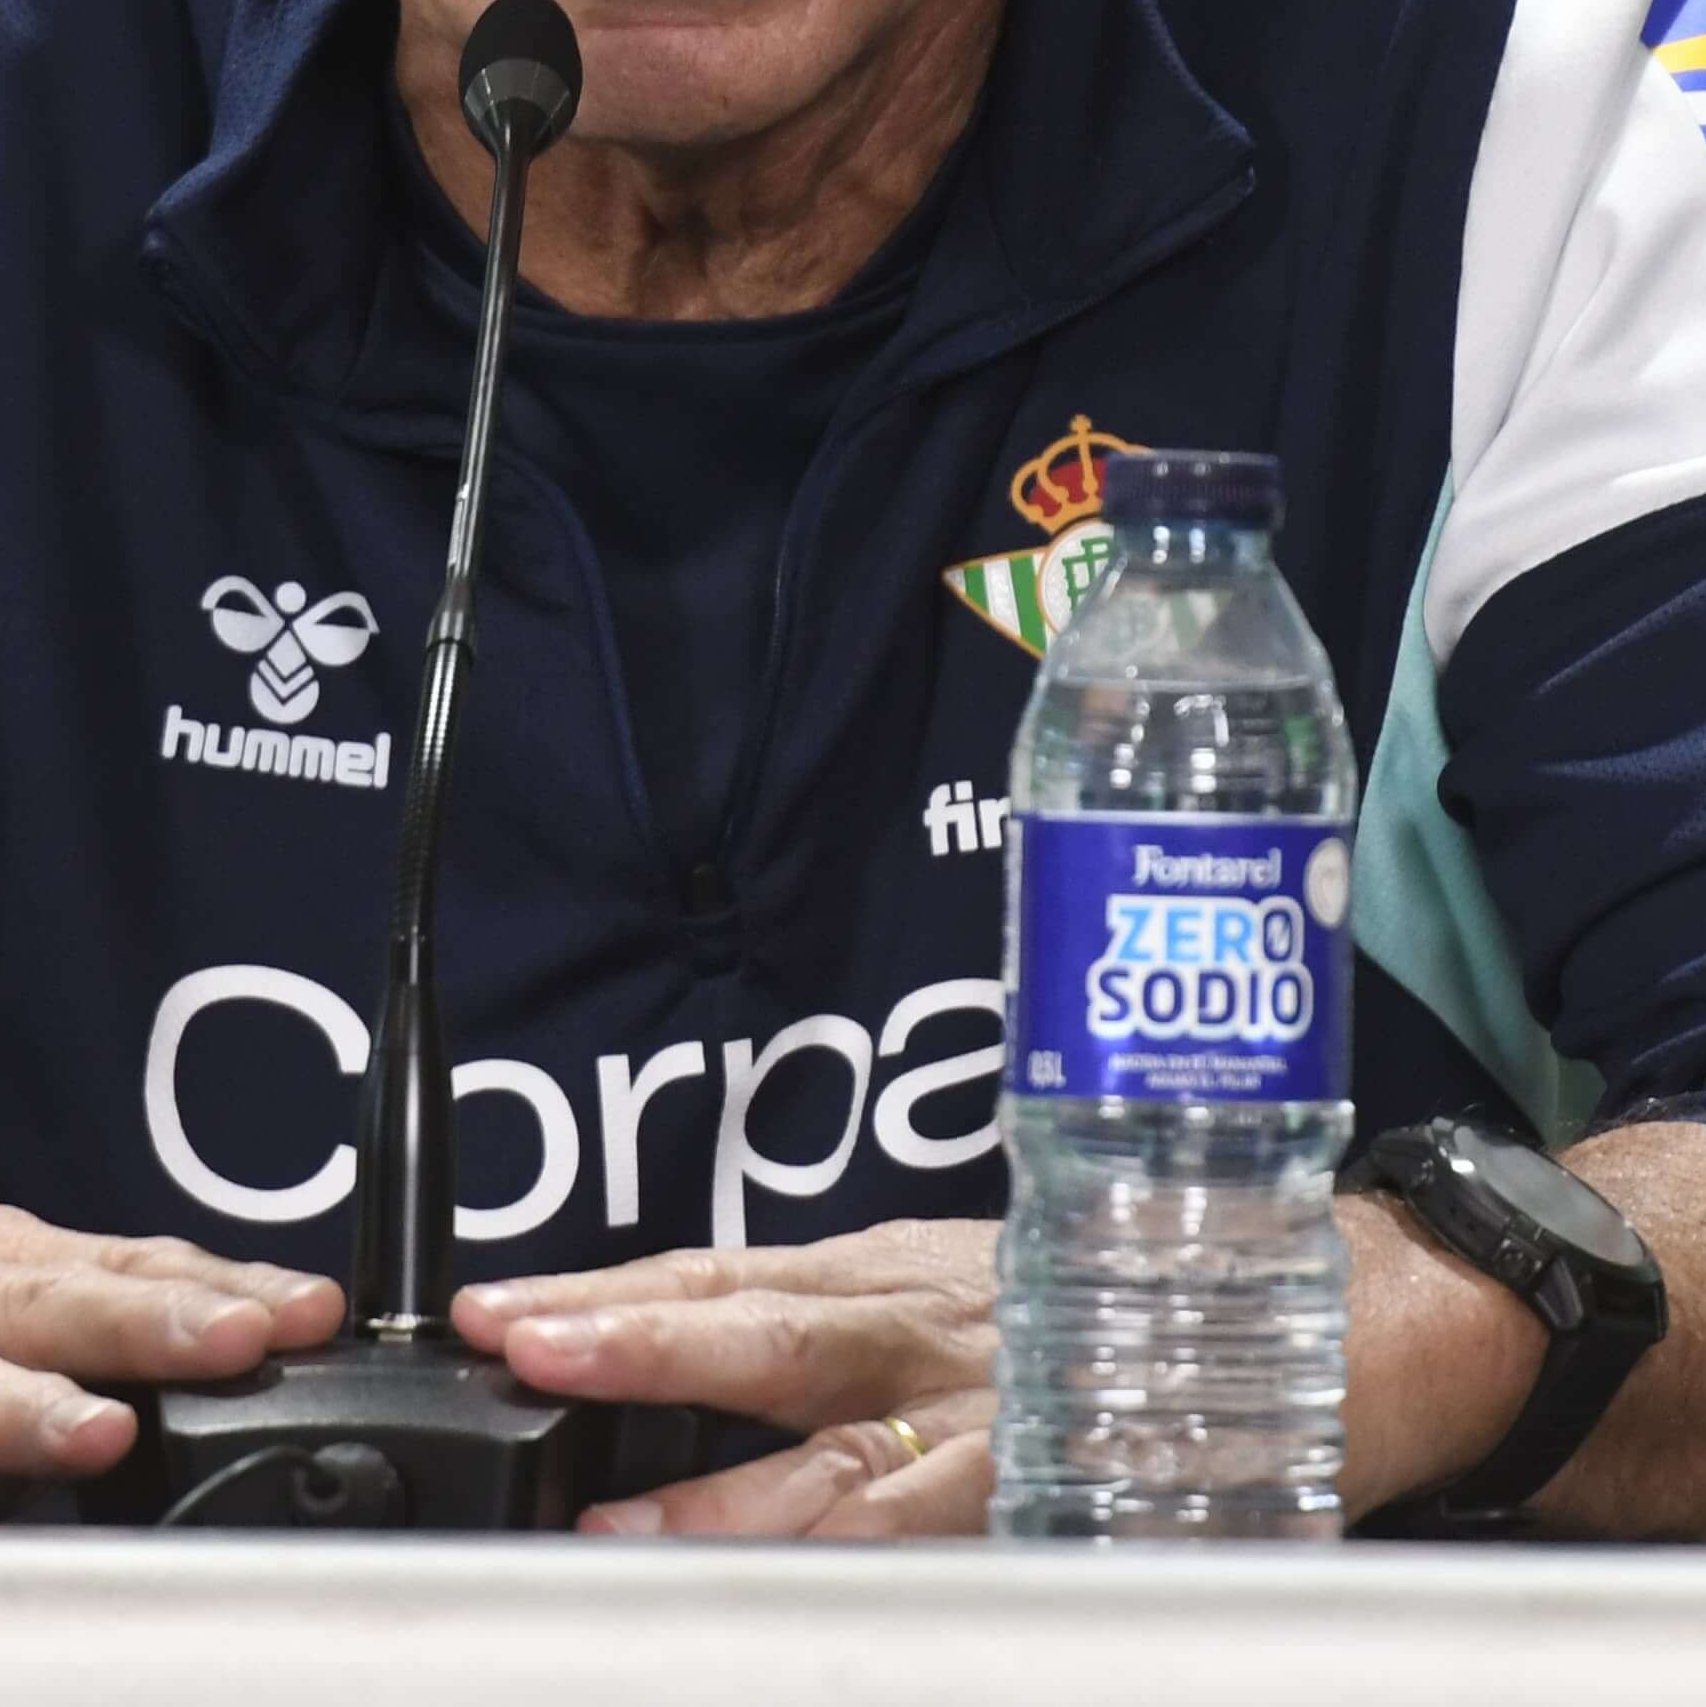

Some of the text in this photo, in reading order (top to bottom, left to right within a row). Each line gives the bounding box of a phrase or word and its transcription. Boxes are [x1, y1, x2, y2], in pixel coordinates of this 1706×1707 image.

[161, 704, 392, 790] hummel
[1112, 902, 1297, 965] ZERO
[1097, 968, 1303, 1027] SODIO
